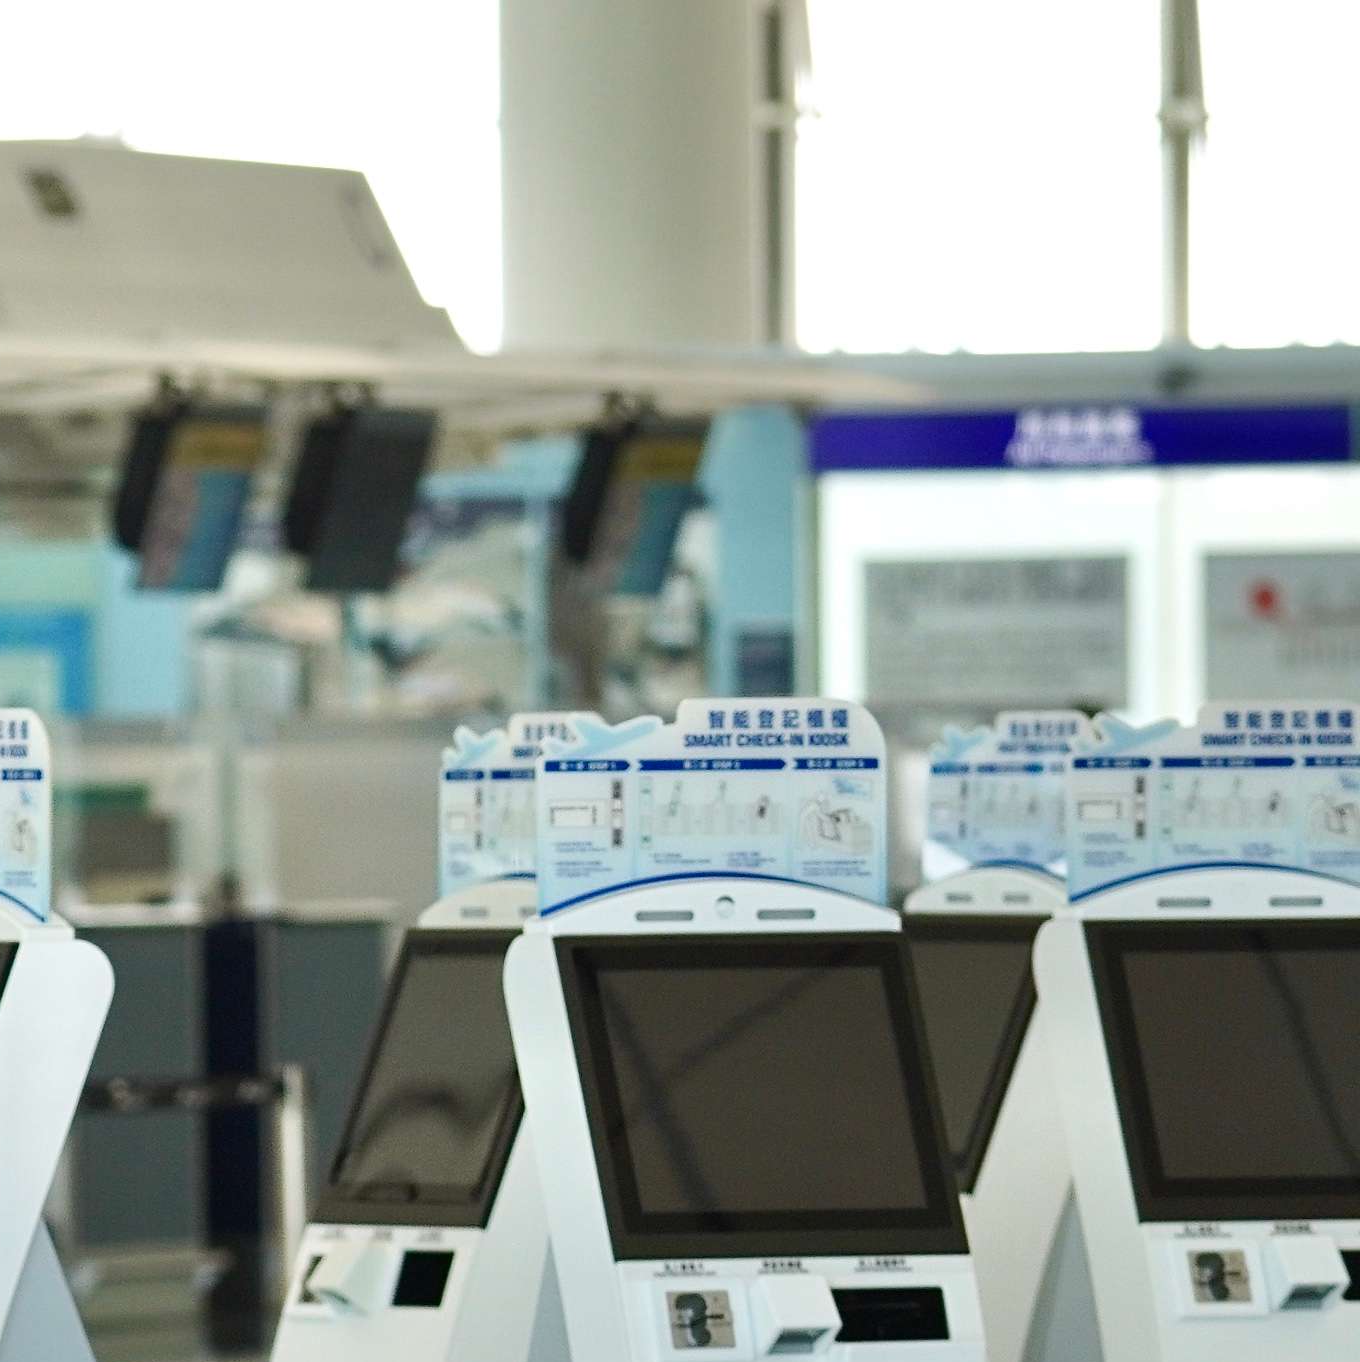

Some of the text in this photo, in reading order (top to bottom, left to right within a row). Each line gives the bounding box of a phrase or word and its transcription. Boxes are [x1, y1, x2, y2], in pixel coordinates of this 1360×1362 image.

[684, 733, 849, 748] SMART CHECK-IN KIOSK
